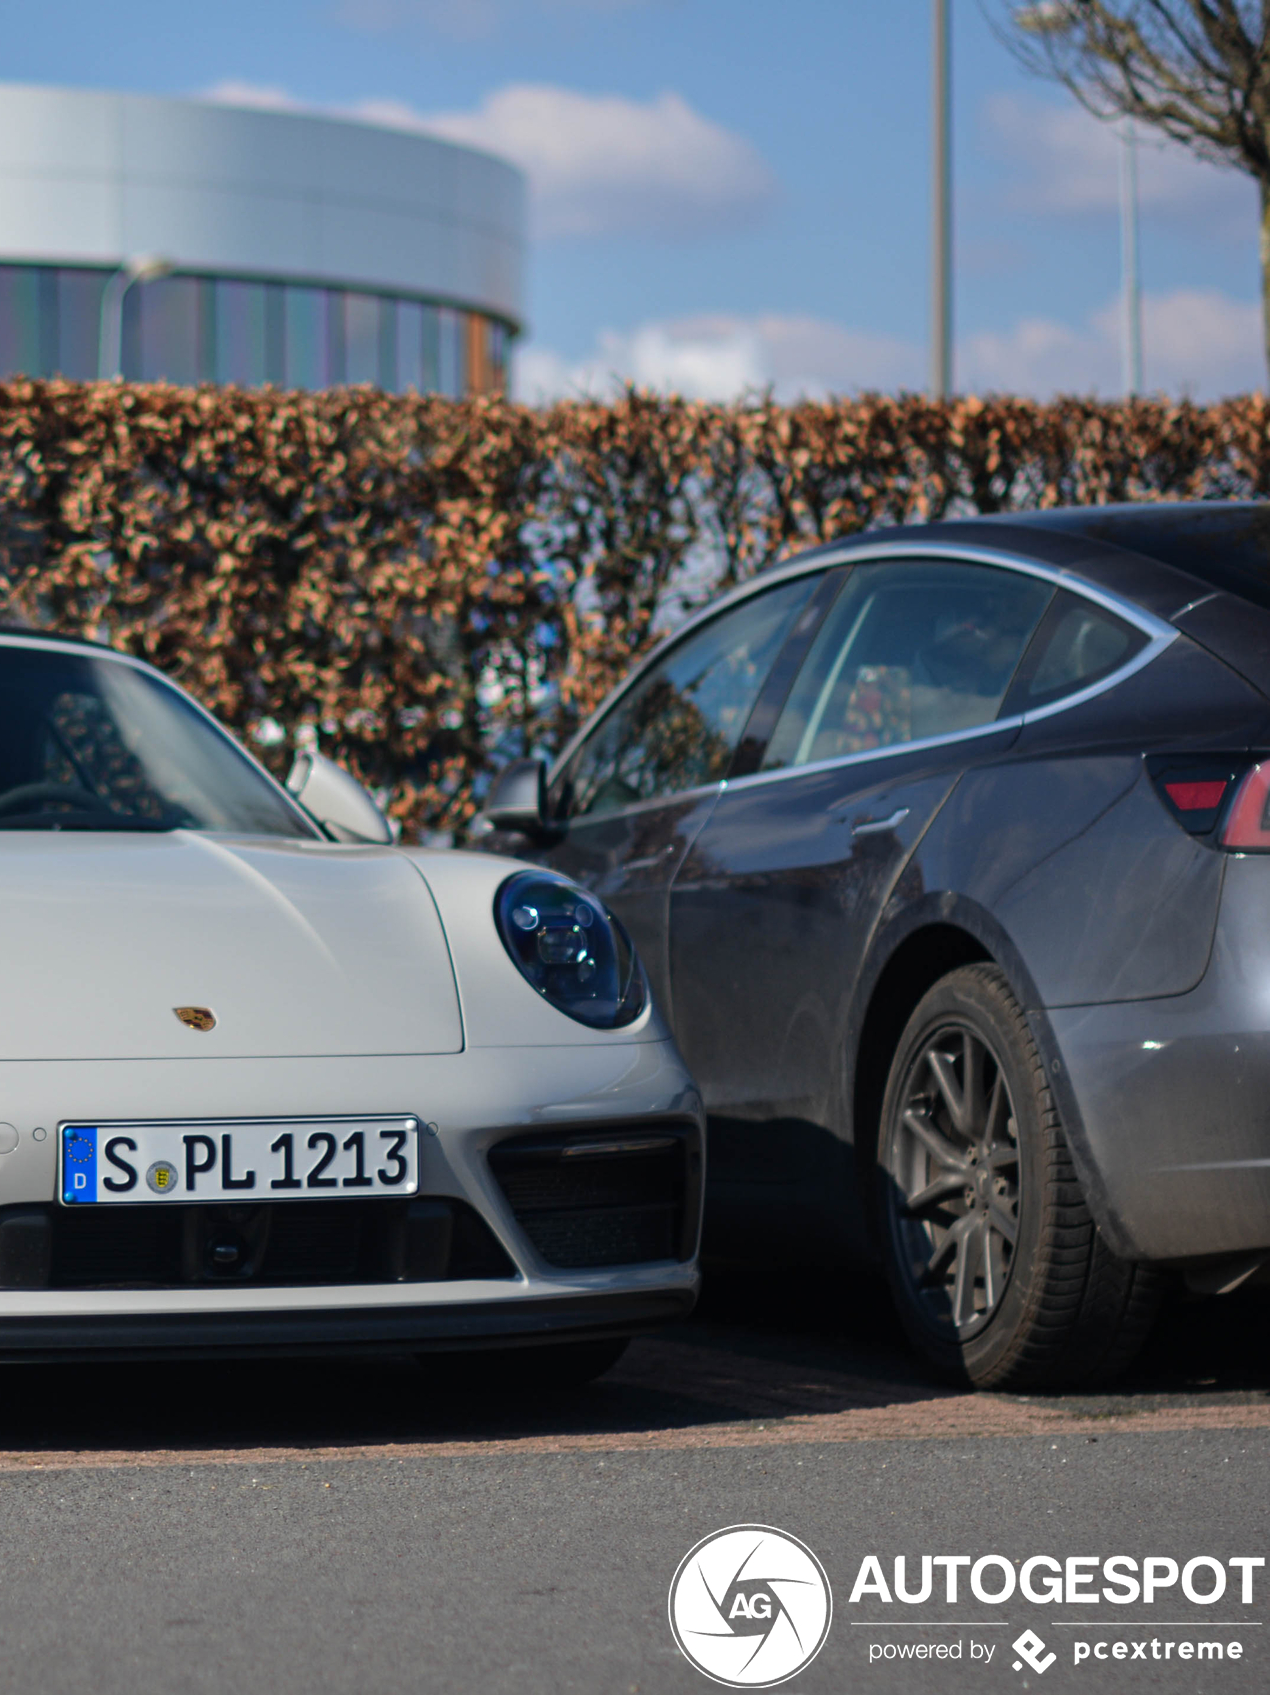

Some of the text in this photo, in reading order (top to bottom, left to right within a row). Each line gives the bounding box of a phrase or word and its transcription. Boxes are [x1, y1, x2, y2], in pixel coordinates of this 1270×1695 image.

[102, 1130, 408, 1192] S PL 1213
[74, 1173, 87, 1190] D
